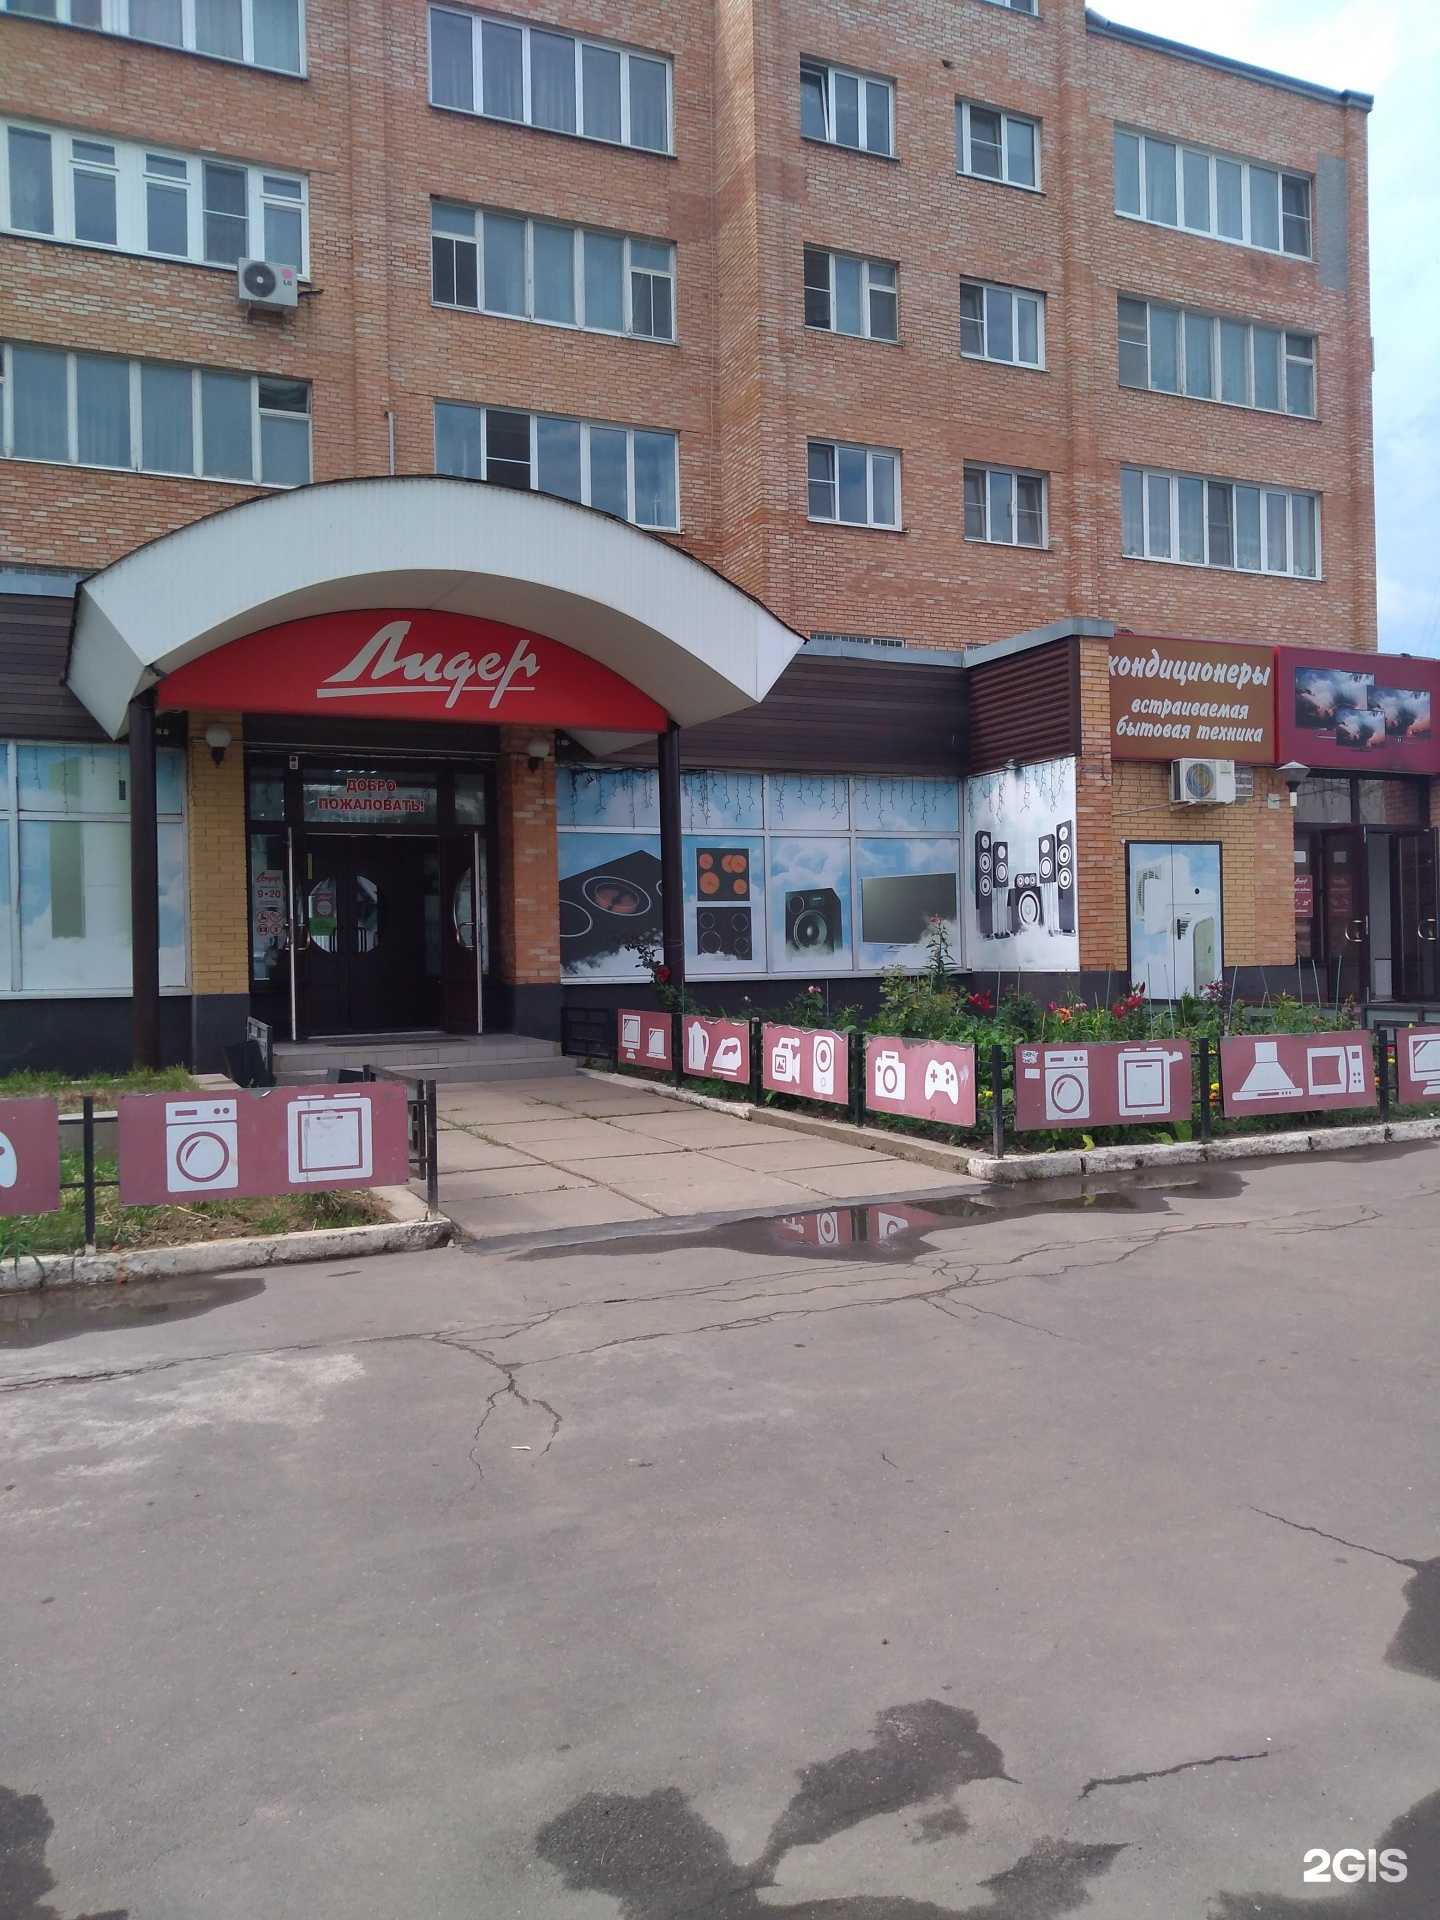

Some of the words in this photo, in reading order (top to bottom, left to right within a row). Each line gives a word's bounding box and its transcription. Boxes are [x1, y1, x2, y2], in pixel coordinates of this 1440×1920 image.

[321, 620, 541, 709] Лидер
[1108, 648, 1271, 690] кондиционеры
[1131, 698, 1249, 719] встраиваемая
[1116, 715, 1191, 739] бытовая
[1196, 723, 1264, 742] техника
[346, 778, 398, 793] ДОБРО
[318, 798, 425, 812] ПОЖАЛОВАТЬ!
